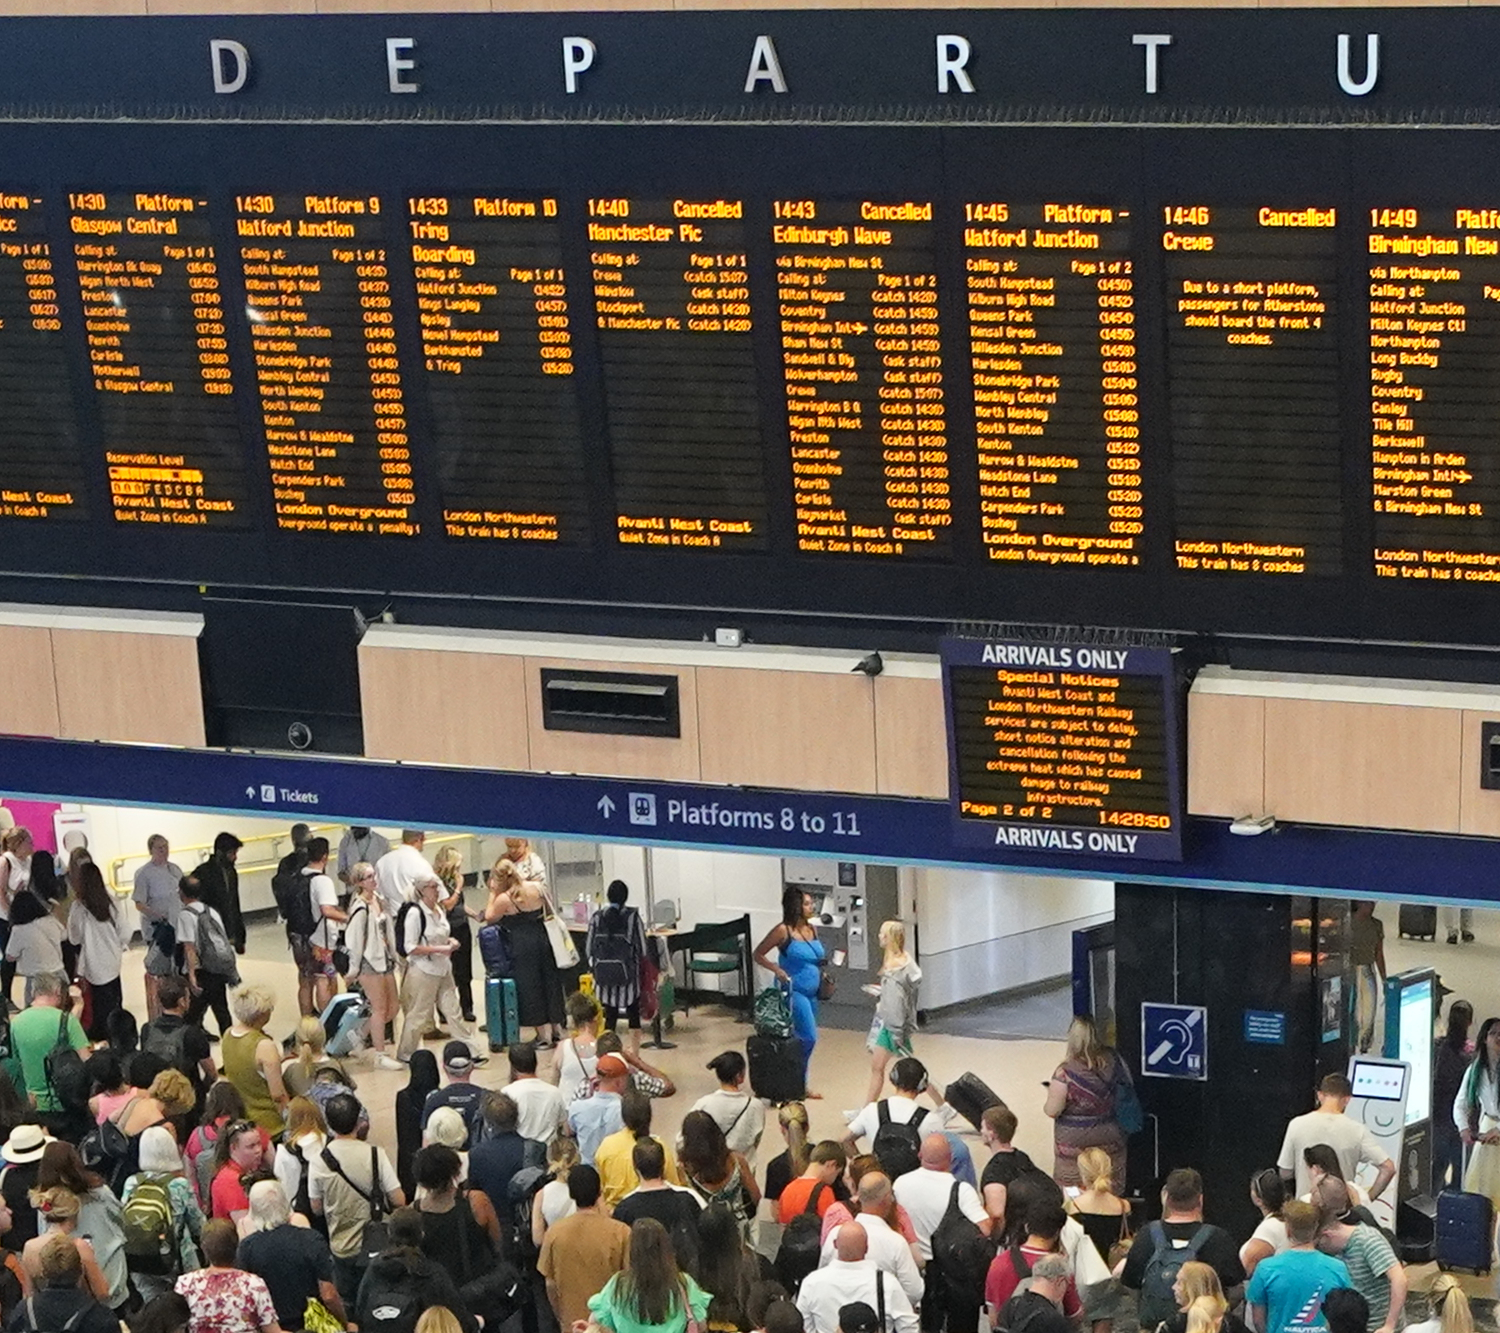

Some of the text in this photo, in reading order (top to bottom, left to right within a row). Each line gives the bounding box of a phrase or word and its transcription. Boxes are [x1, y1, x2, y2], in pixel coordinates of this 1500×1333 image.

[409, 198, 557, 216] 14:33 Platform 10
[589, 199, 742, 218] 14:40 Cancelled
[774, 201, 932, 220] 14:43 Cancelled
[966, 204, 1112, 223] 14:45 Platform
[1165, 207, 1335, 226] 14:46 Cancelled
[1371, 209, 1417, 228] 14:49
[410, 222, 449, 241] Tring
[680, 224, 702, 242] Pic
[774, 225, 849, 246] Edinburgh
[1033, 230, 1099, 248] Junction
[1163, 232, 1214, 250] Crewe
[413, 245, 475, 265] Boarding
[1369, 235, 1459, 256] Birmingham
[1465, 236, 1498, 254] New
[982, 645, 1127, 669] ARRIVALS ONLY
[998, 670, 1119, 687] Special Notices
[280, 789, 318, 804] Tickets
[668, 800, 860, 834] Platforms 8 to 11
[962, 802, 1052, 818] Page 2 of 2
[1100, 811, 1170, 828] 14:28:50
[996, 827, 1137, 853] ARRIVALS ONLY
